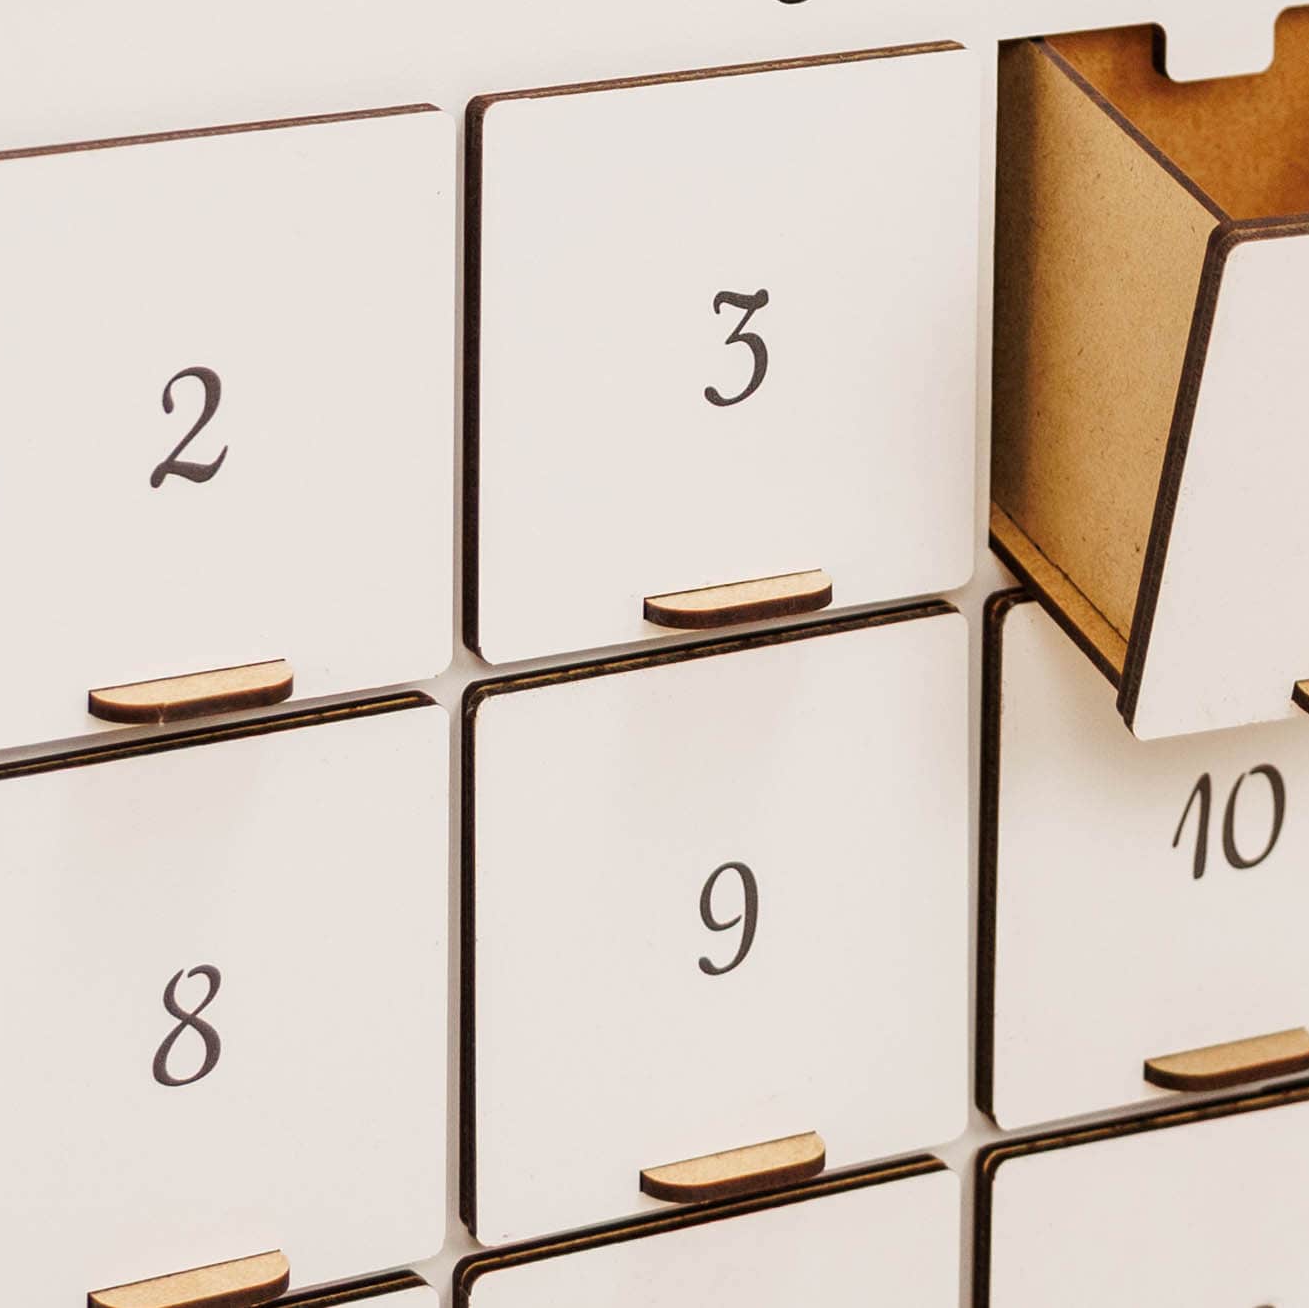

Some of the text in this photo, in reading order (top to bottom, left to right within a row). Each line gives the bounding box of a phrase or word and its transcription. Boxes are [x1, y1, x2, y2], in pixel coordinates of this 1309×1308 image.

[704, 288, 769, 407] 3
[150, 366, 228, 489] 2
[1172, 762, 1286, 881] 10
[698, 861, 759, 976] 9
[152, 964, 221, 1087] 8
